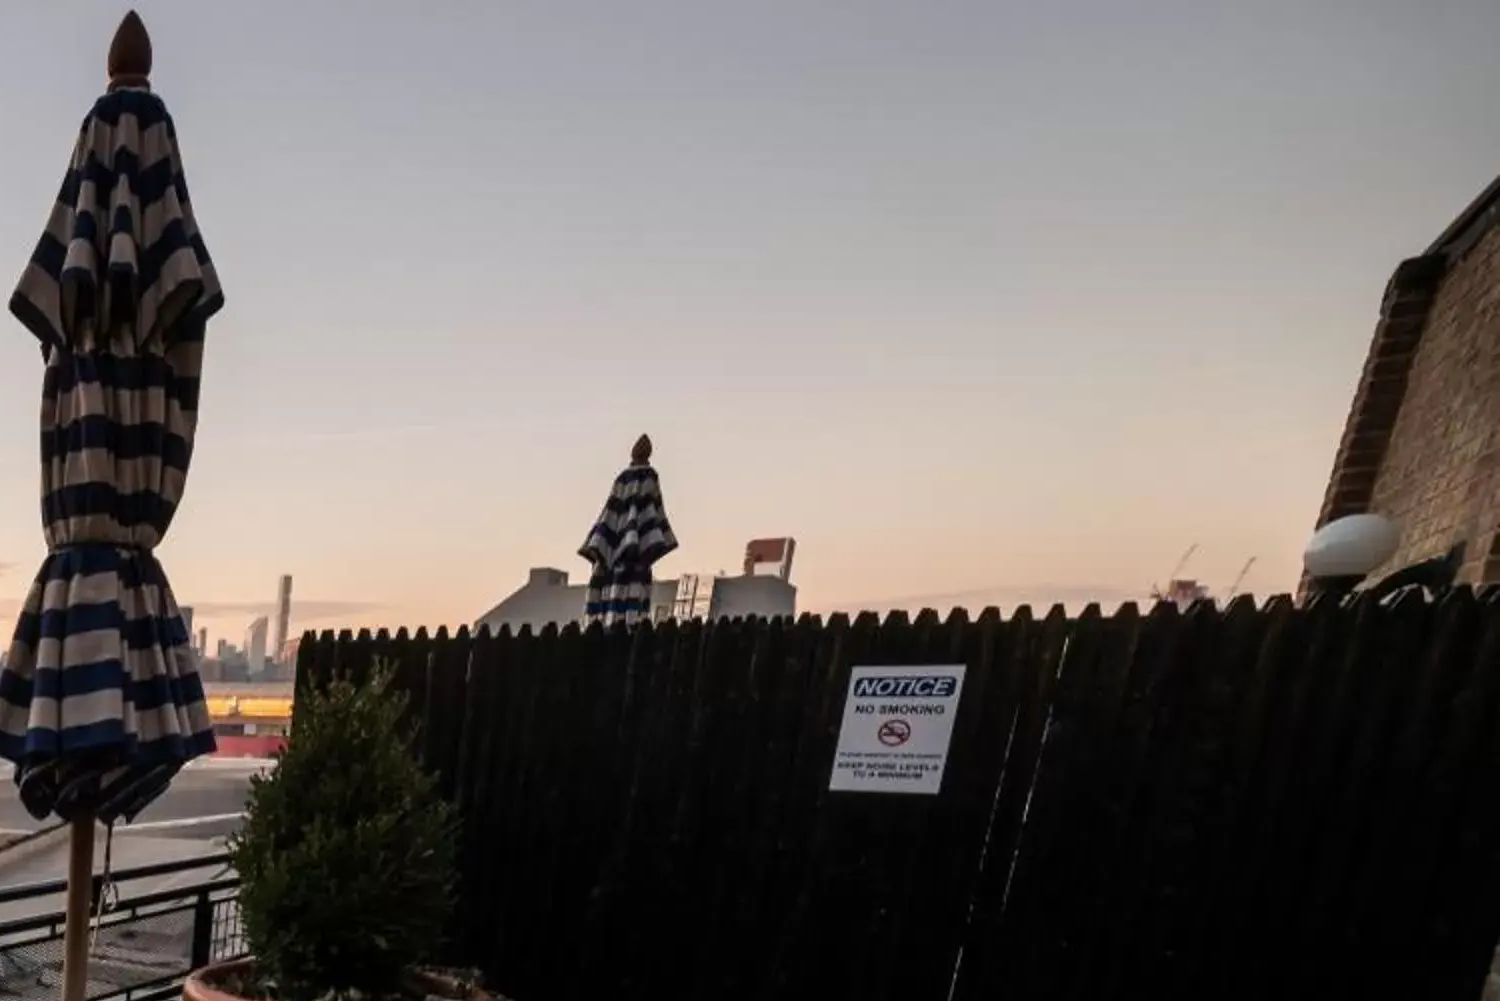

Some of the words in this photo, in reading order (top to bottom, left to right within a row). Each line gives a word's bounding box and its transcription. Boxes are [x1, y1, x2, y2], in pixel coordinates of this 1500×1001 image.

[857, 679, 953, 695] NOTICE
[856, 704, 875, 714] NO
[879, 704, 945, 715] SMOKING
